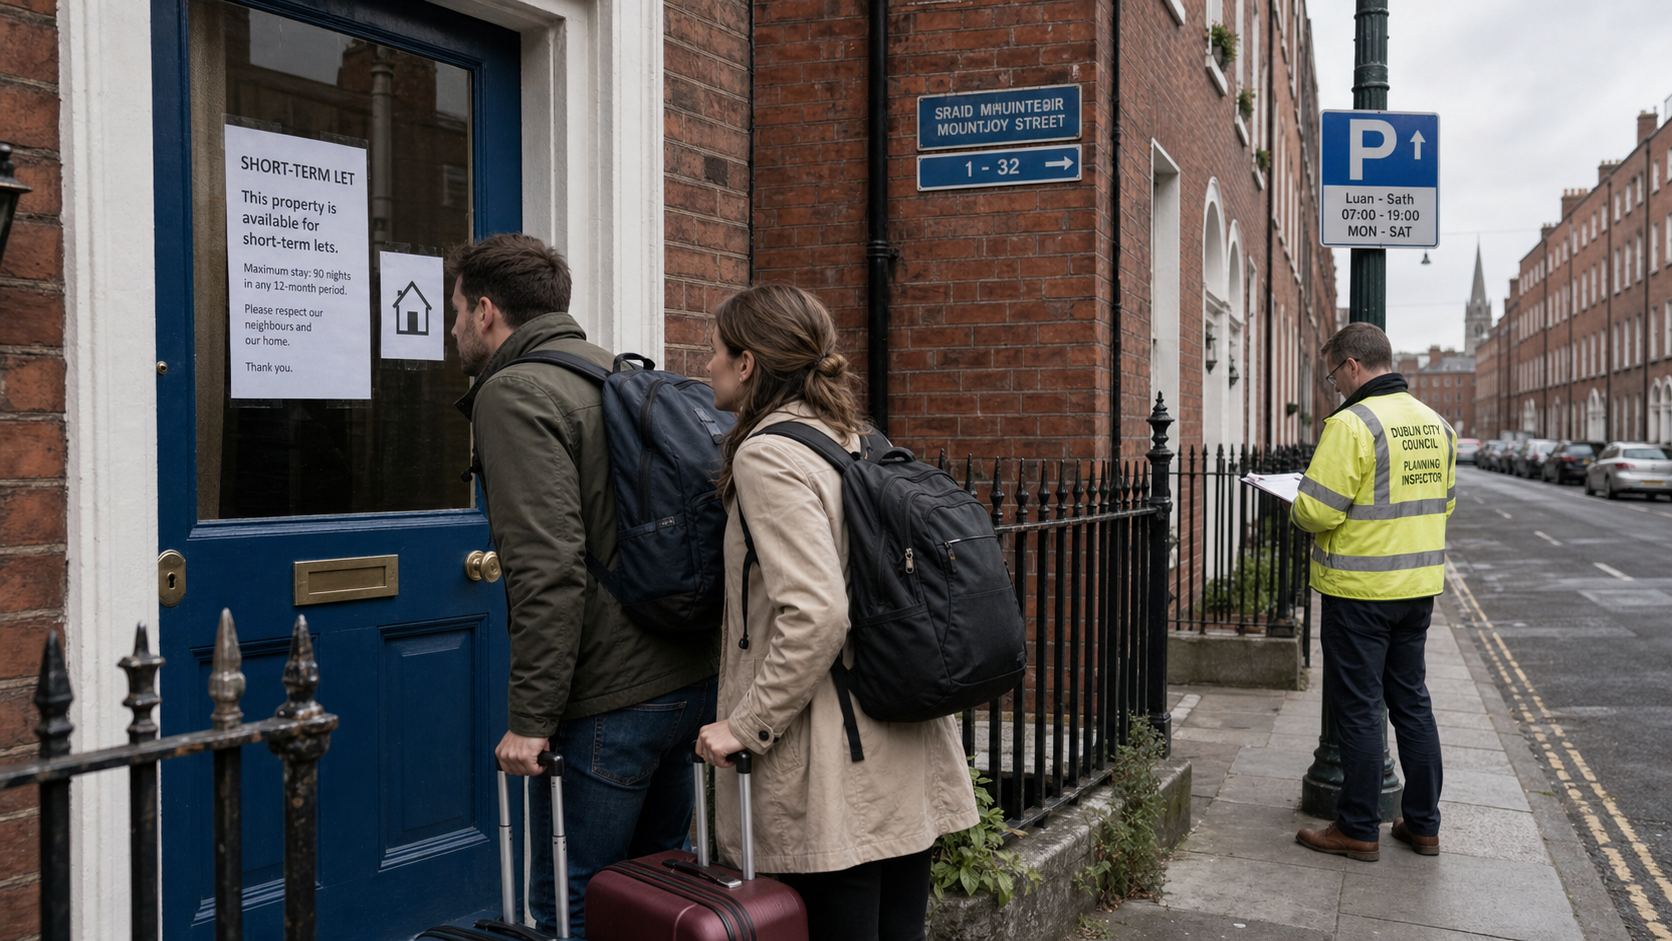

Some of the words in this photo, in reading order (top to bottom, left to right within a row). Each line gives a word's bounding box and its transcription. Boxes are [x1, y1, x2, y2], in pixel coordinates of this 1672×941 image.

[935, 105, 973, 120] SRAID
[938, 118, 1009, 136] MOUNTJOY
[1015, 114, 1065, 130] STREET
[1349, 119, 1397, 180] P
[241, 155, 330, 182] SHORT-TERM
[334, 170, 355, 186] LET
[965, 161, 972, 177] 1
[997, 158, 1019, 175] 32
[241, 190, 268, 205] This
[272, 197, 325, 216] property
[328, 201, 337, 214] is
[1346, 192, 1374, 204] Luan
[1387, 193, 1414, 205] Sath
[1342, 208, 1376, 221] 07:00
[1387, 209, 1420, 221] 19:00
[242, 213, 299, 230] available
[302, 217, 320, 231] for
[1348, 225, 1377, 237] MON
[1389, 226, 1412, 238] SAT
[243, 232, 310, 251] short-term
[314, 239, 338, 253] lets.
[244, 263, 289, 275] Maximum
[291, 268, 311, 279] stay:
[313, 268, 324, 278] 90
[326, 270, 351, 282] nights
[244, 278, 252, 288] in
[255, 282, 271, 292] any
[274, 281, 316, 293] 12-month
[319, 285, 347, 295] period.
[245, 304, 273, 315] Please
[275, 308, 307, 318] respect
[245, 320, 294, 333] neighbours
[296, 322, 312, 332] and
[245, 337, 261, 345] our
[263, 335, 290, 346] home.
[245, 362, 272, 372] Thank
[274, 365, 293, 374] you.
[1391, 426, 1421, 438] DUBLIN
[1423, 425, 1440, 435] CITY
[1402, 438, 1438, 451] COUNCIL
[1404, 459, 1441, 471] PLANNING
[1402, 472, 1442, 486] INSPECTOR
